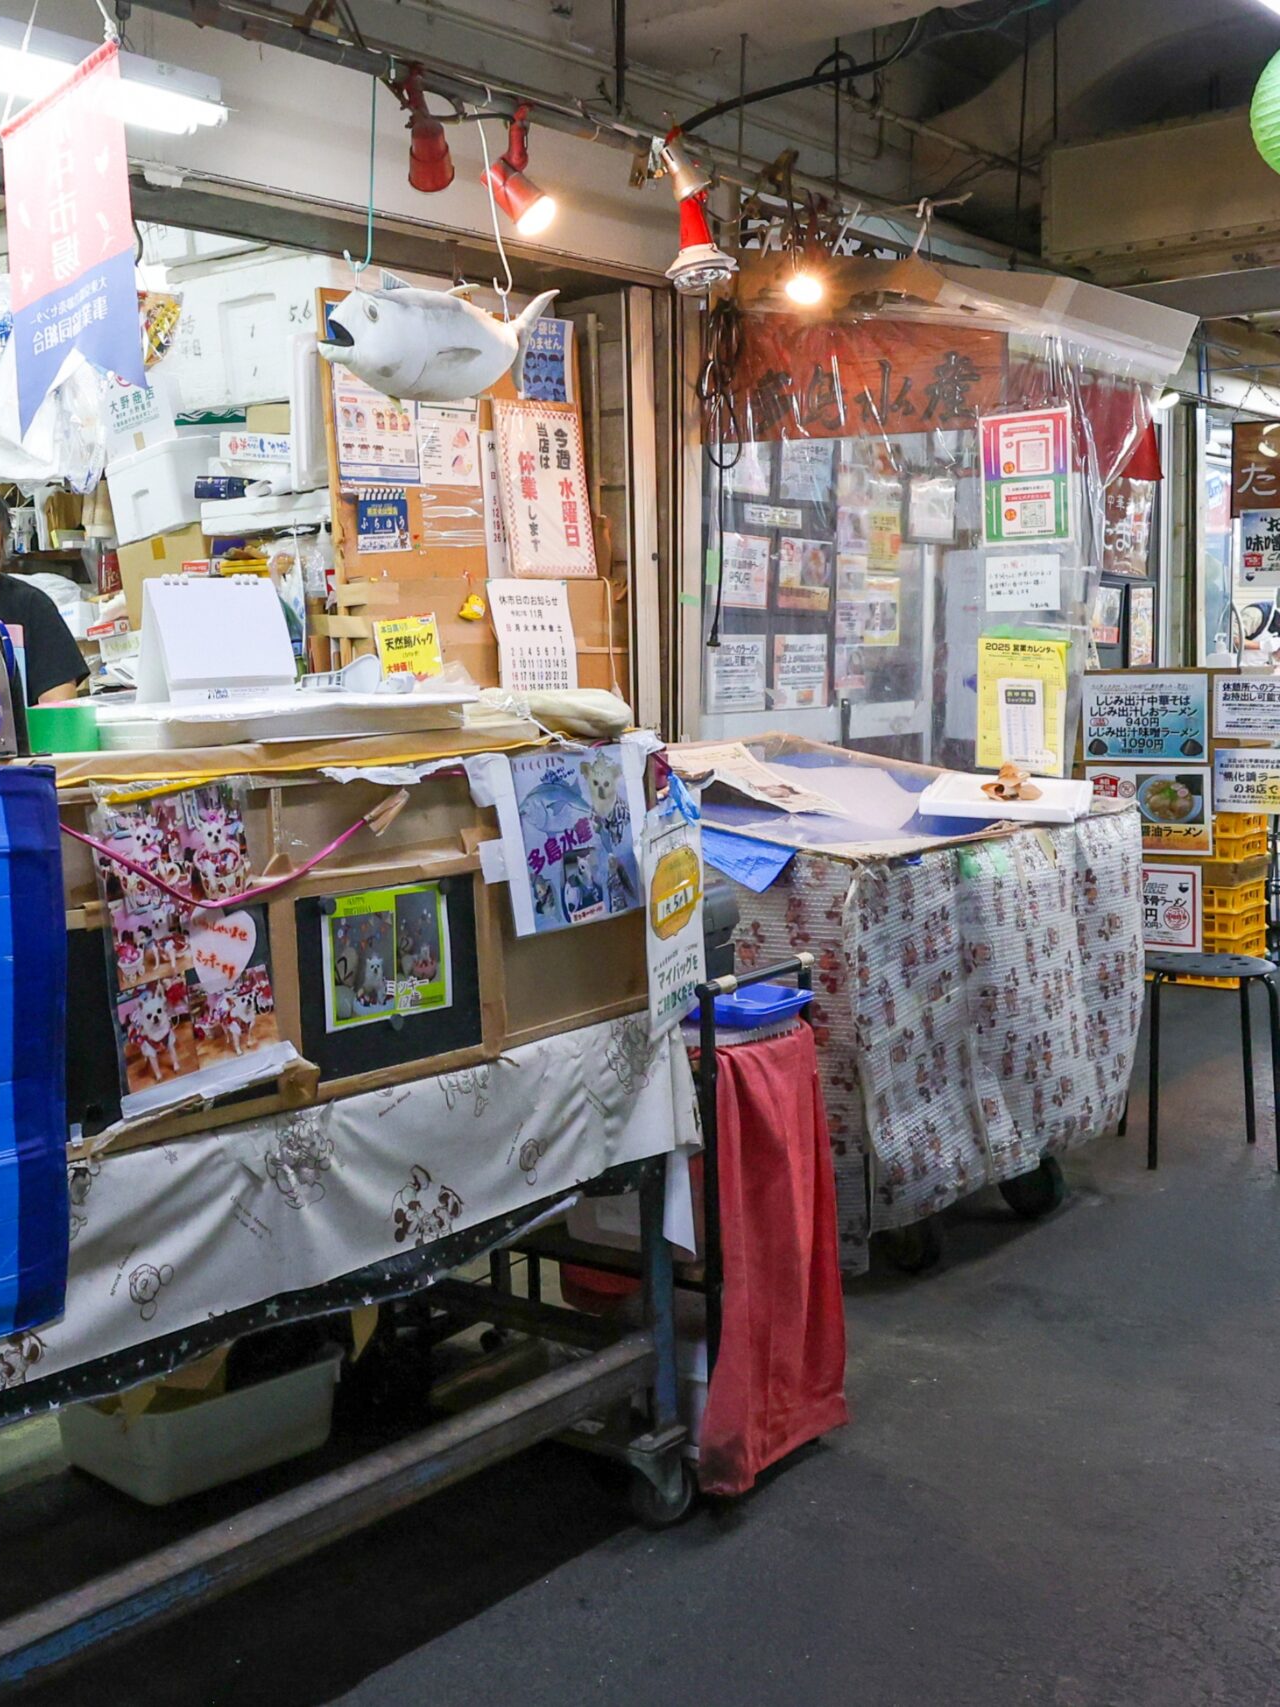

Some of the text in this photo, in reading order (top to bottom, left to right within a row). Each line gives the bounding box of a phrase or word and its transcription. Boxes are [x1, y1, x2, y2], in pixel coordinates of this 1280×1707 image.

[536, 422, 551, 469] 当店は
[554, 428, 581, 547] 今週 水曜日
[517, 451, 542, 552] 休業 します
[499, 595, 558, 606] 休市日のお知らせ
[985, 642, 1010, 651] 2025
[1096, 695, 1191, 706] しじみ出汁中華そば
[1090, 706, 1198, 717] しじみ出汁しおラーメン
[1125, 717, 1159, 727] 940円
[1088, 727, 1199, 738] しじみ出汁味噌ラーメン
[1122, 738, 1163, 749] 1090円
[527, 817, 593, 875] 多島水産
[1143, 883, 1168, 894] 限定
[658, 953, 699, 989] マイバッグを
[384, 975, 430, 996] ミッキー
